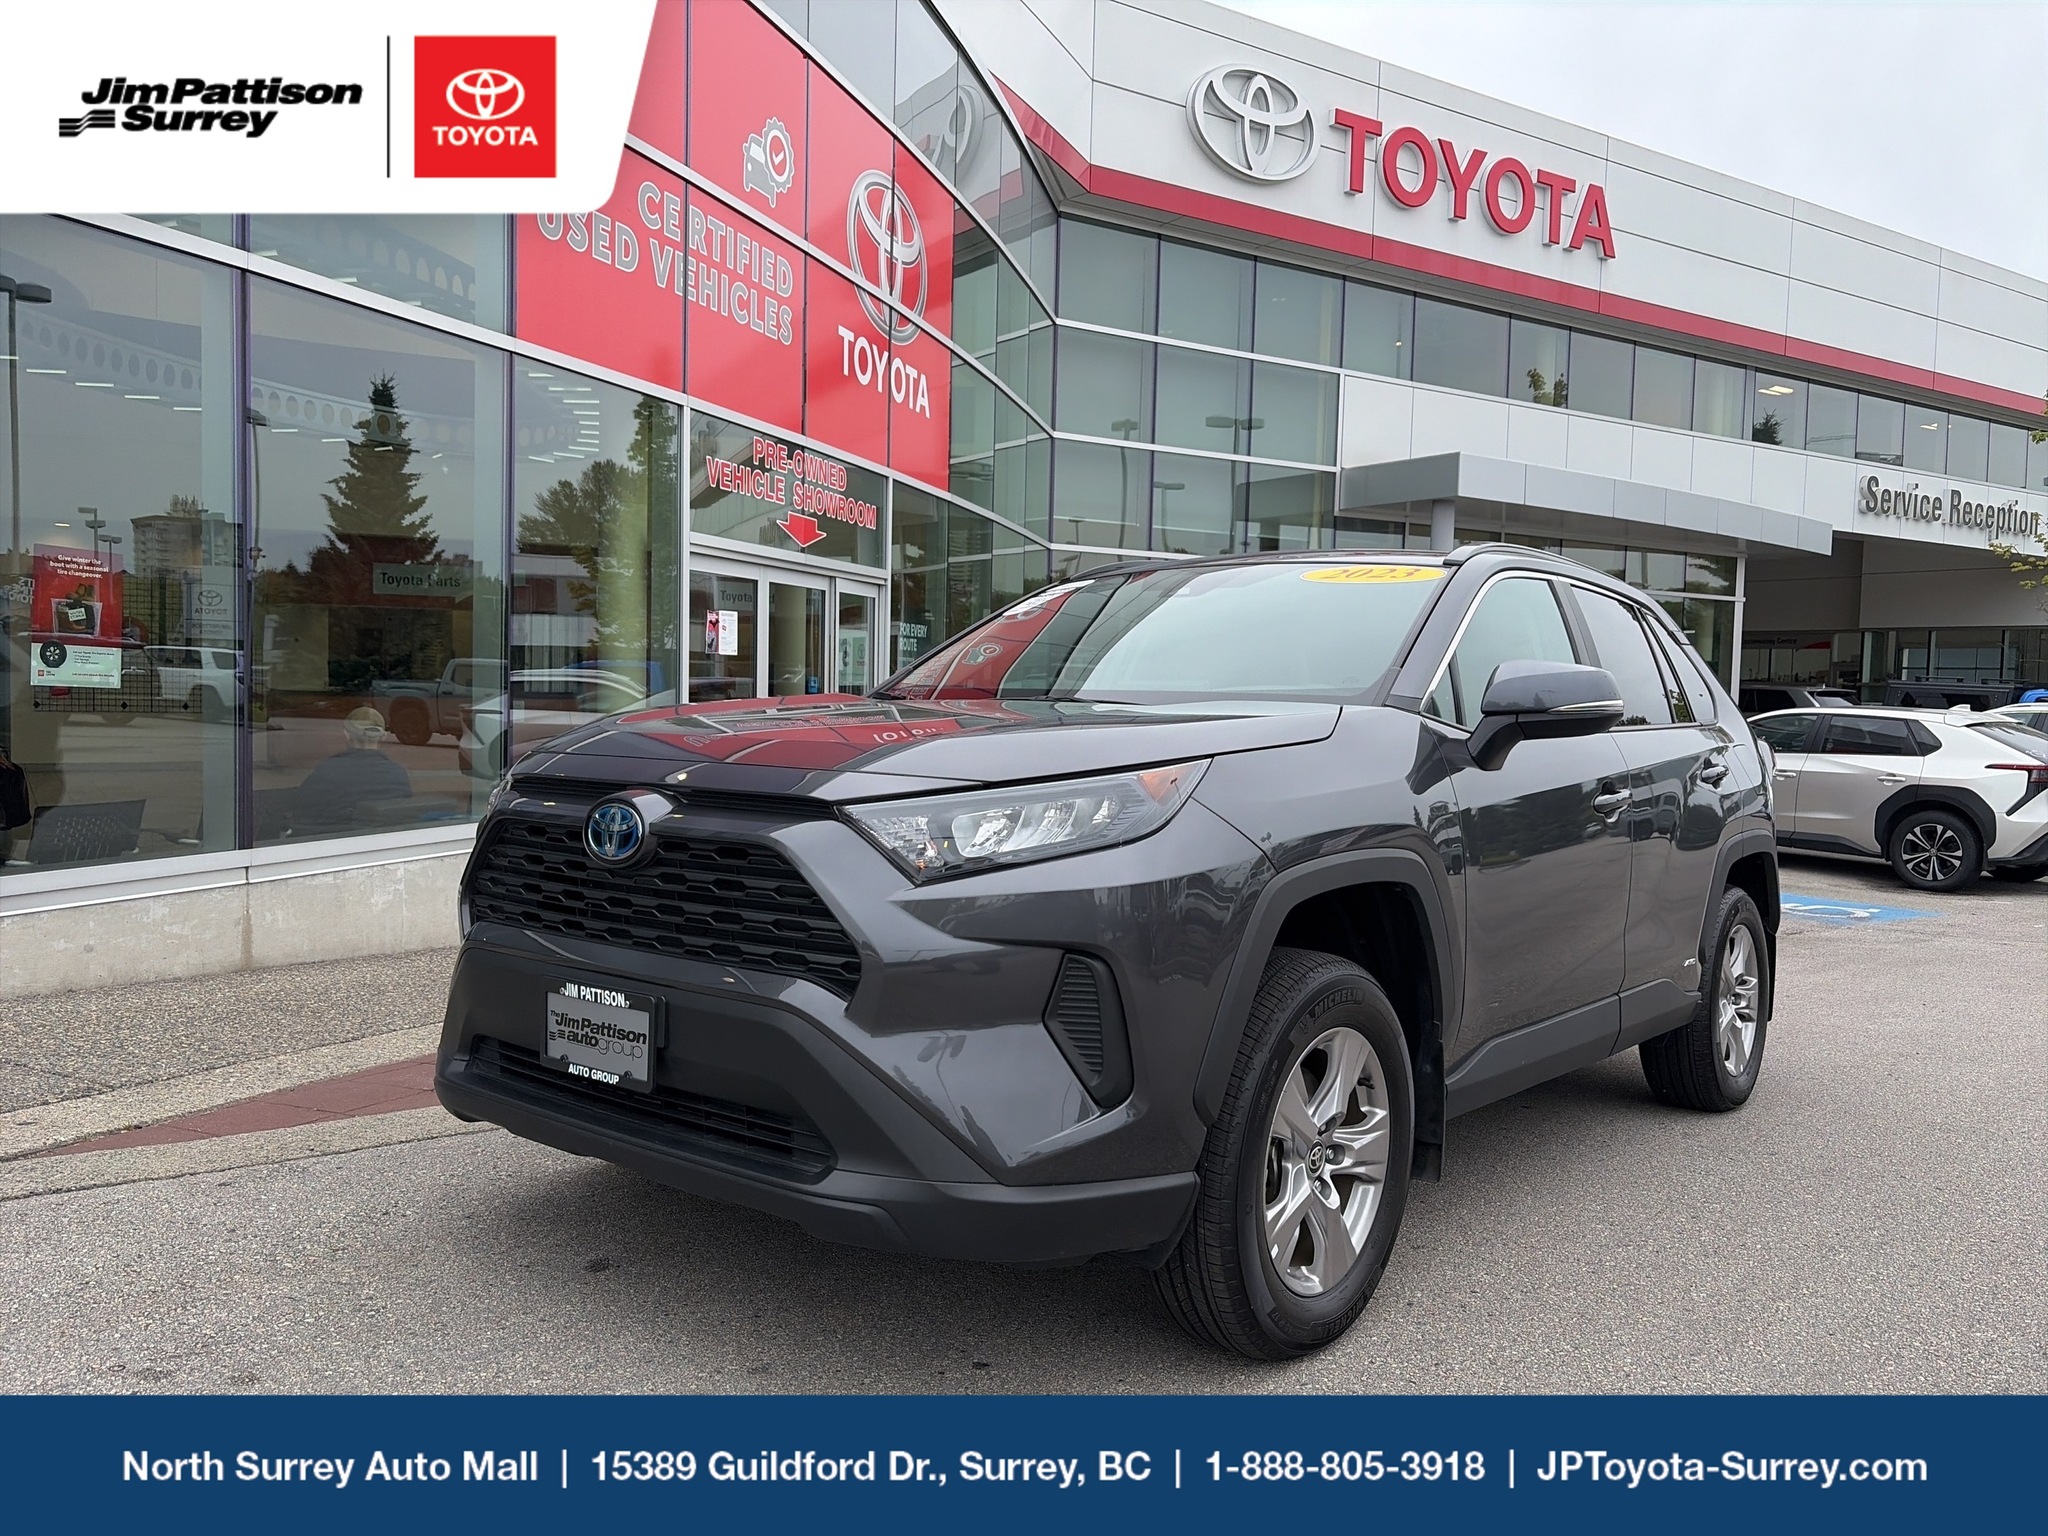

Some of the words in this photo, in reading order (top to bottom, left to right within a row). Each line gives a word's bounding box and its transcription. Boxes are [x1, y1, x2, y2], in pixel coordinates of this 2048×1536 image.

[1329, 108, 1616, 260] TOYOTA
[638, 181, 793, 298] CERTIFIED
[537, 211, 639, 273] USED
[649, 238, 792, 346] VEHICLES
[838, 325, 930, 419] TOYOTA
[753, 436, 847, 492] PRE-OWNED
[706, 456, 786, 505] VEHICLE
[793, 482, 877, 530] SHOWROOM
[1860, 475, 1943, 523] Service
[1947, 489, 2040, 540] Reception
[58, 554, 71, 562] Give
[65, 562, 79, 570] with
[83, 565, 109, 573] seasonal
[68, 570, 103, 579] changeover.
[381, 572, 423, 588] Toyota
[1319, 568, 1422, 579] 2023
[720, 590, 753, 604] Toyota
[900, 622, 911, 637] FOR
[911, 623, 928, 638] EVERY
[900, 637, 918, 652] ROUTE
[564, 982, 579, 999] JIM
[580, 985, 625, 1008] PATTISON
[550, 1010, 560, 1018] The
[568, 1063, 590, 1078] AUTO
[591, 1069, 620, 1085] GROUP
